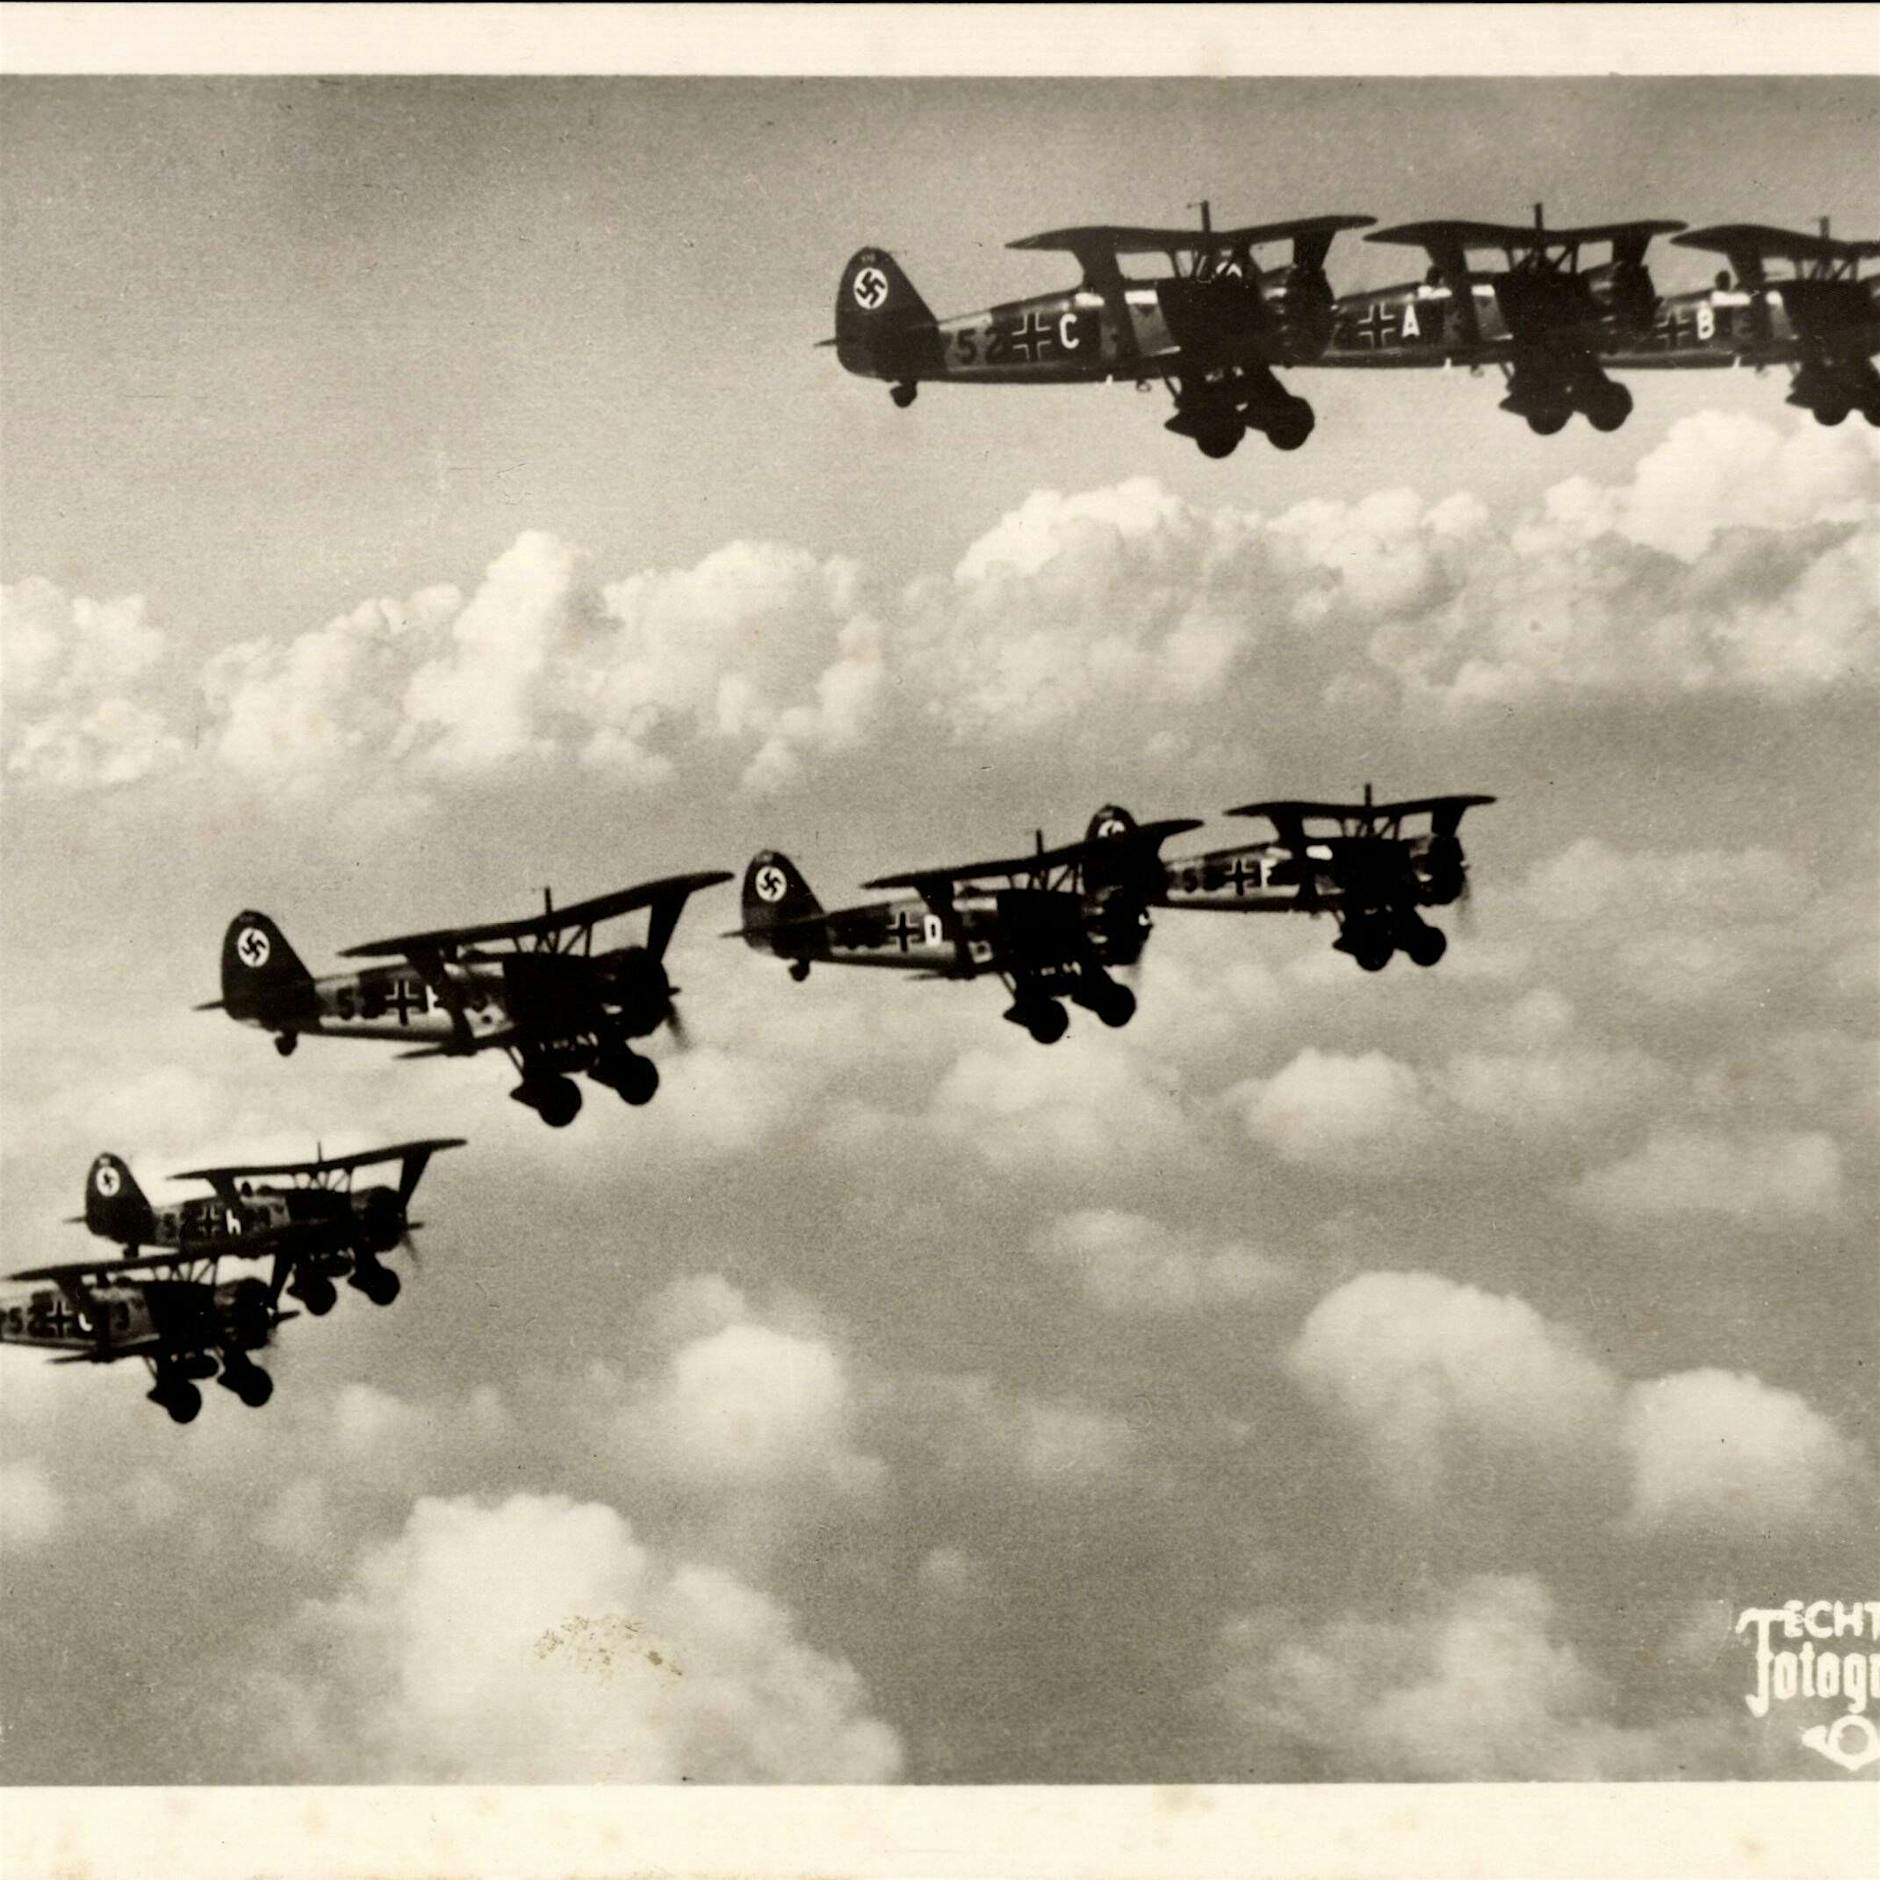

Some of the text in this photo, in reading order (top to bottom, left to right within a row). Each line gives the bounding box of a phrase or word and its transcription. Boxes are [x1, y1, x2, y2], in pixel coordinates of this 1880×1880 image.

[1059, 313, 1080, 350] C
[1401, 303, 1421, 339] A
[1697, 305, 1716, 340] B
[924, 914, 943, 946] D
